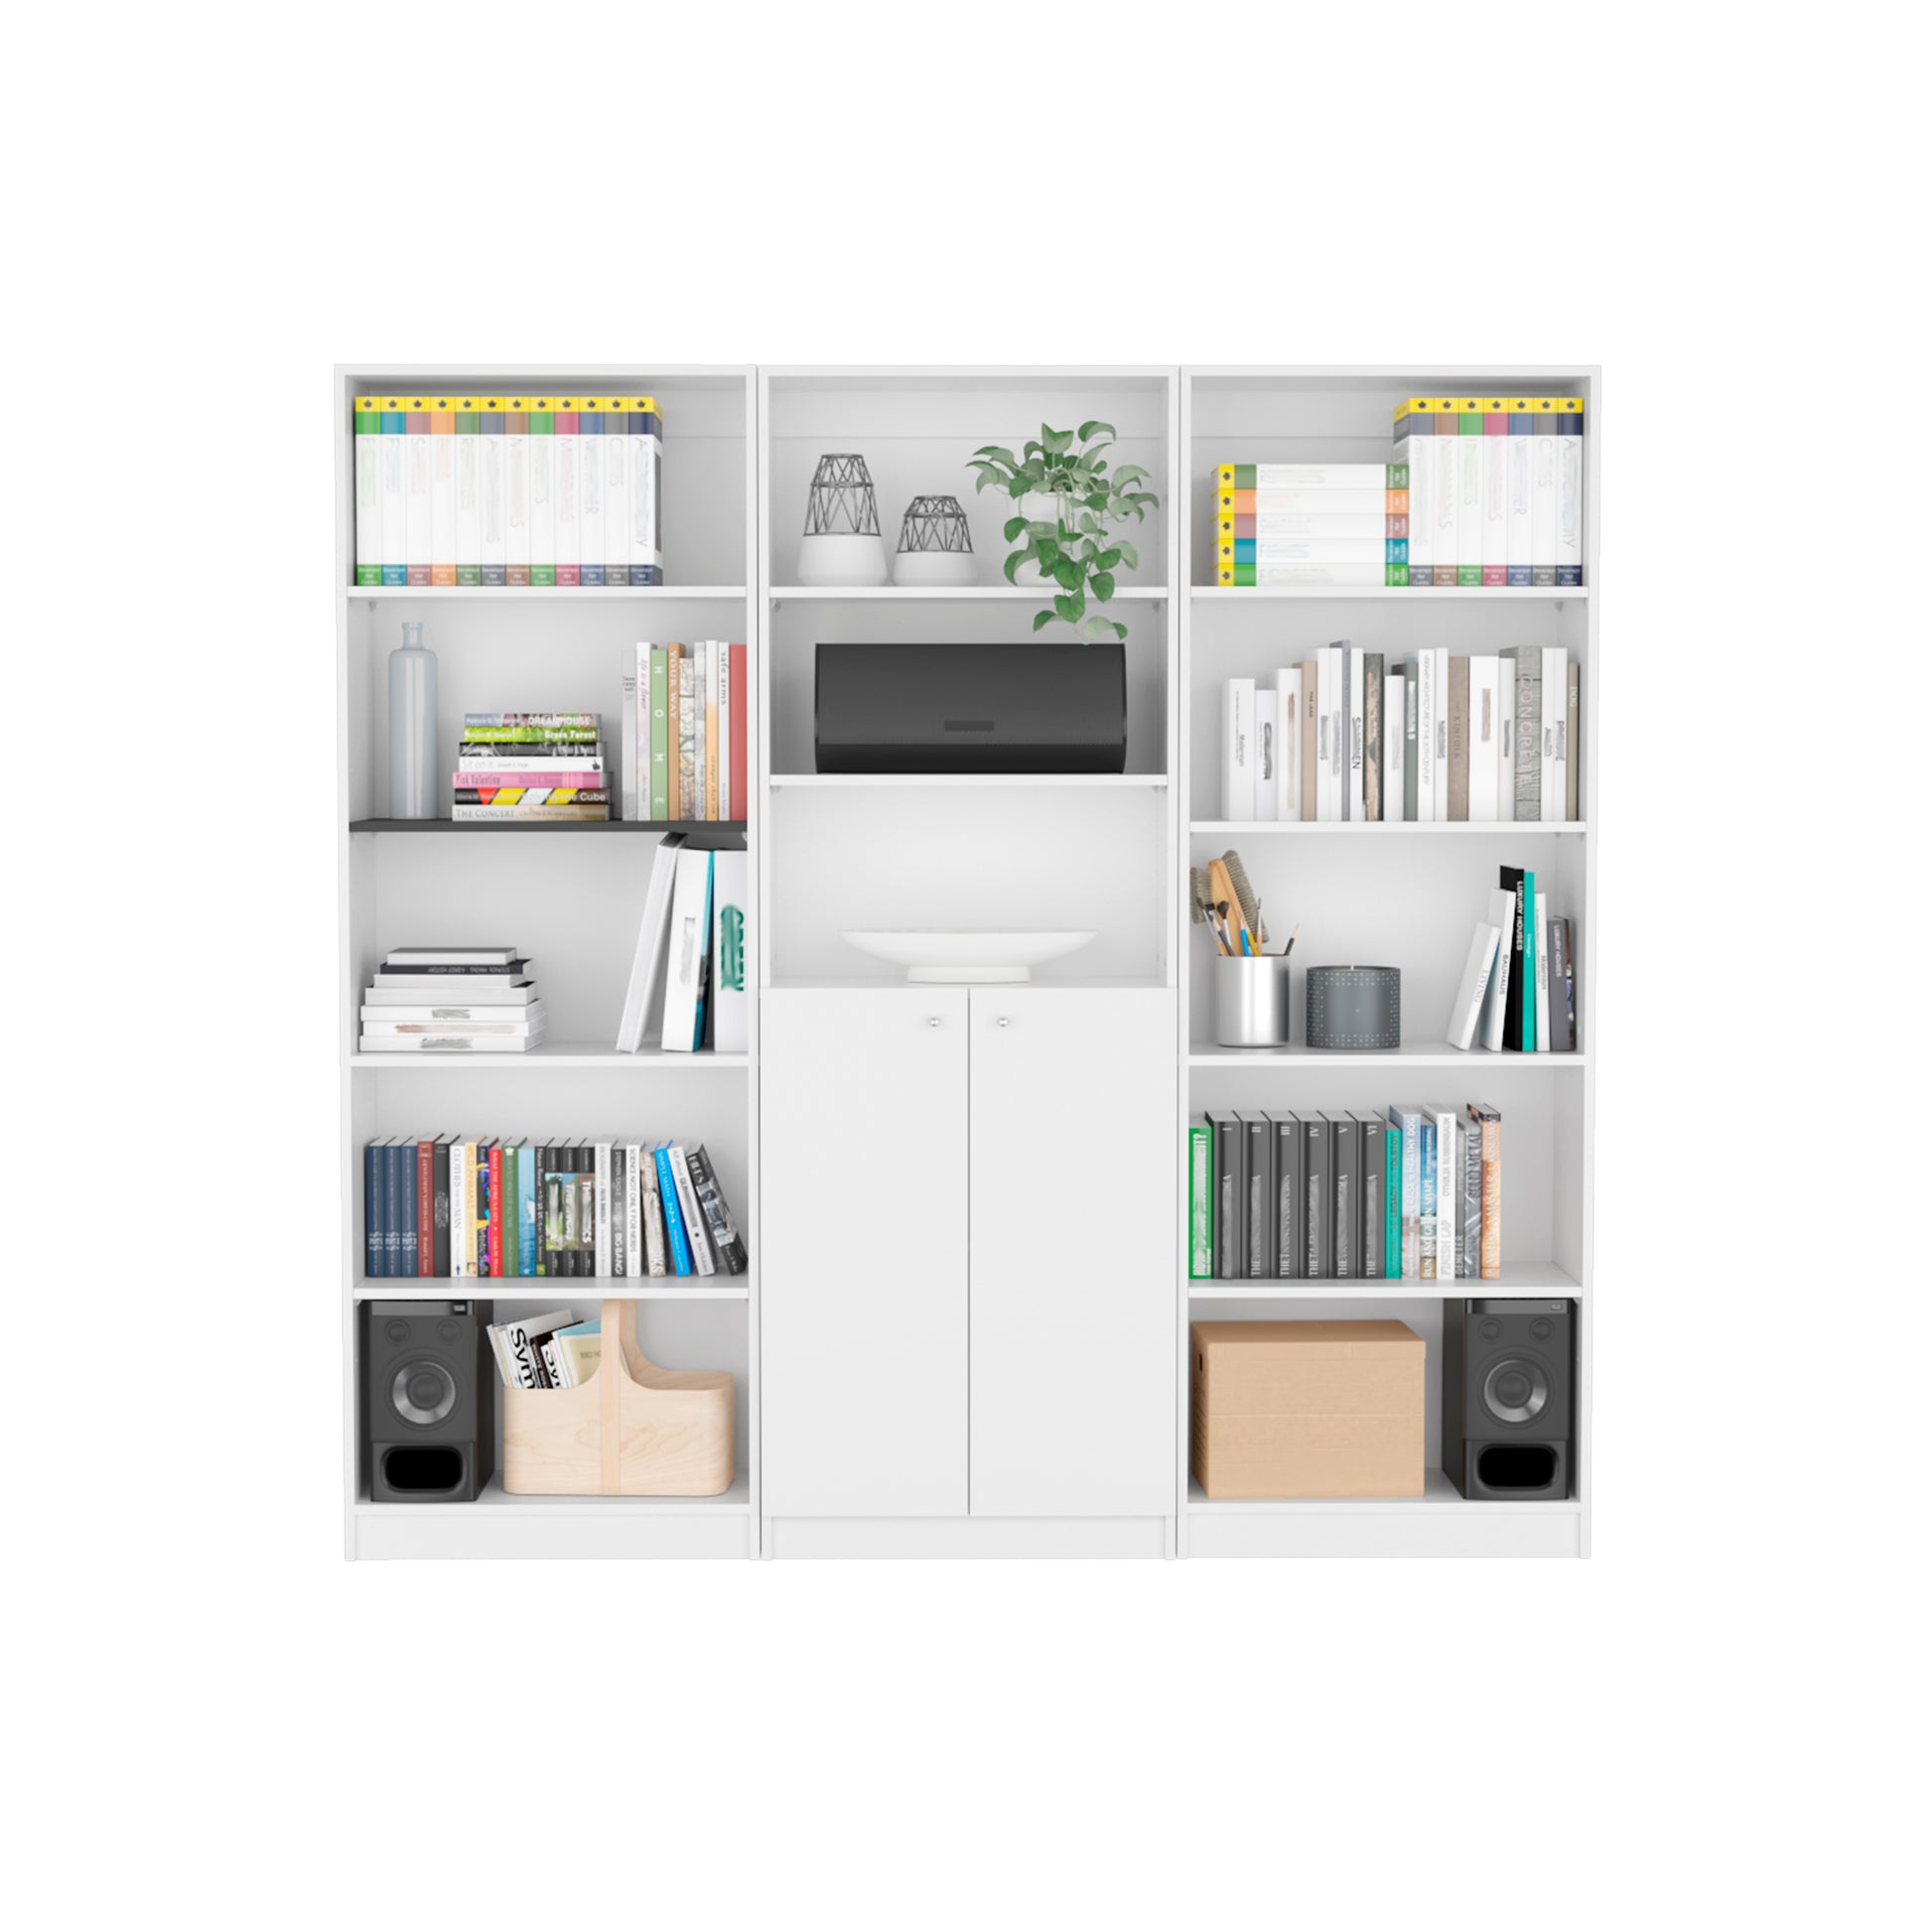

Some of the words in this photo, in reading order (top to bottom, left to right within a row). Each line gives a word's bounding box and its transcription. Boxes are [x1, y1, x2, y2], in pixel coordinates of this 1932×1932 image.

[456, 774, 469, 784] Pink
[471, 774, 500, 784] Valentine
[476, 809, 515, 818] CONCERT
[1553, 924, 1562, 949] LUXURY
[1499, 954, 1509, 995] BAUHAUS
[1310, 1127, 1318, 1137] IV
[1367, 1125, 1376, 1135] VI
[1424, 1177, 1433, 1205] SHAPE
[1442, 1240, 1451, 1276] FINISH
